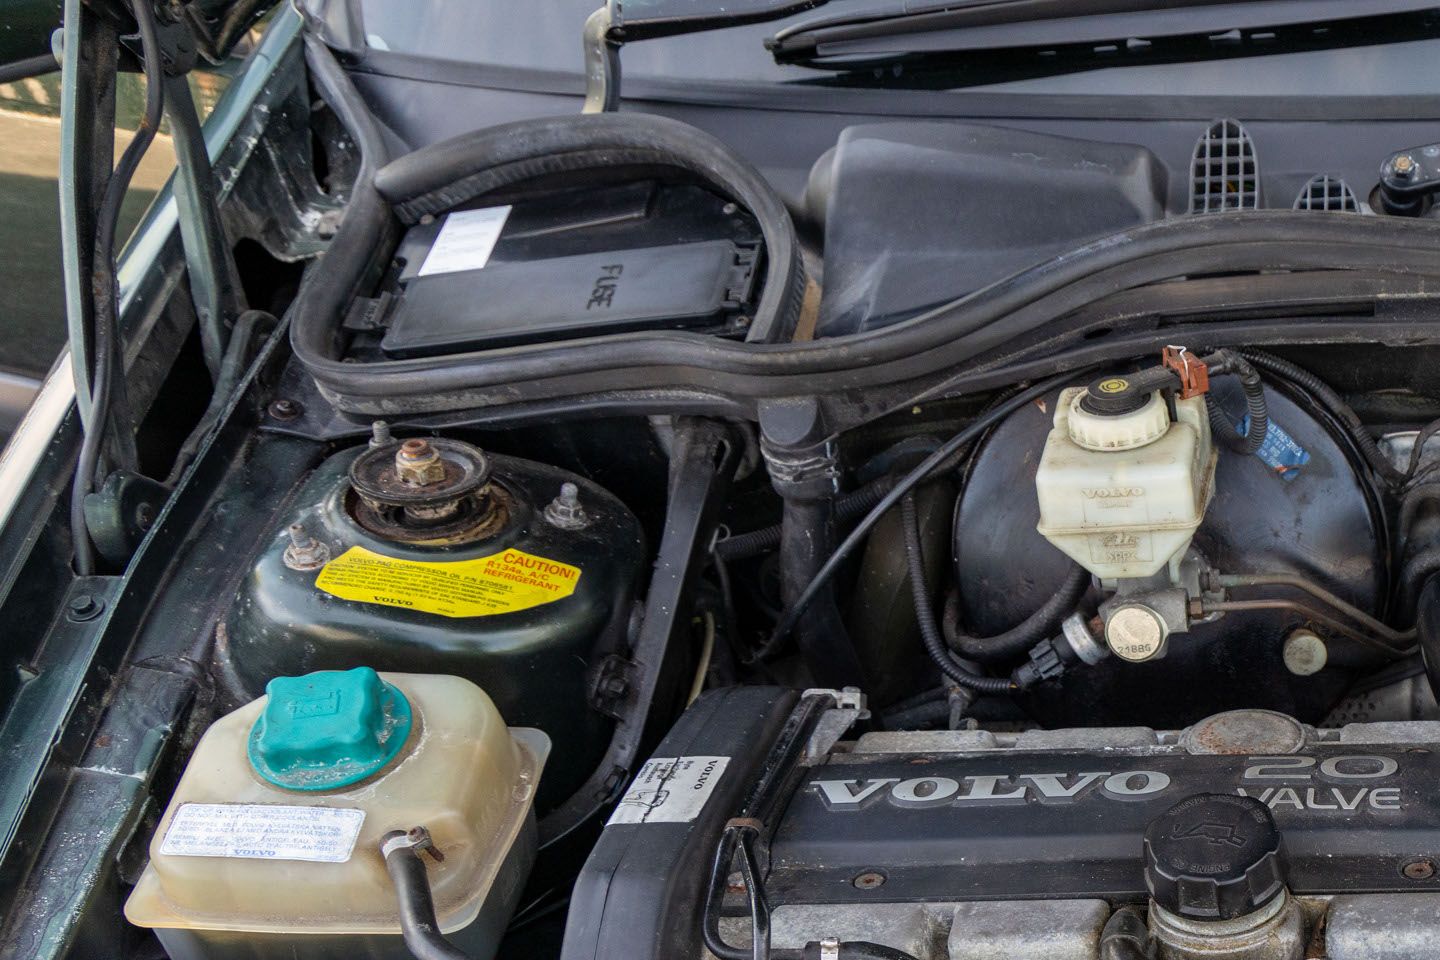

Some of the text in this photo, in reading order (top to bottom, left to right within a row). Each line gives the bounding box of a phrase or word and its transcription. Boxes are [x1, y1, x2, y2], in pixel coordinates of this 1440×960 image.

[586, 264, 624, 310] FUSE
[1081, 487, 1145, 498] VOLVO
[503, 552, 577, 580] CAUTION!
[528, 571, 550, 581] A/C
[483, 568, 561, 592] REFRIGERANT
[373, 596, 414, 606] VOLVO
[693, 760, 718, 790] VOLVO
[1244, 755, 1399, 779] 20
[809, 770, 1172, 805] VOLVO
[1236, 788, 1401, 810] VALVE
